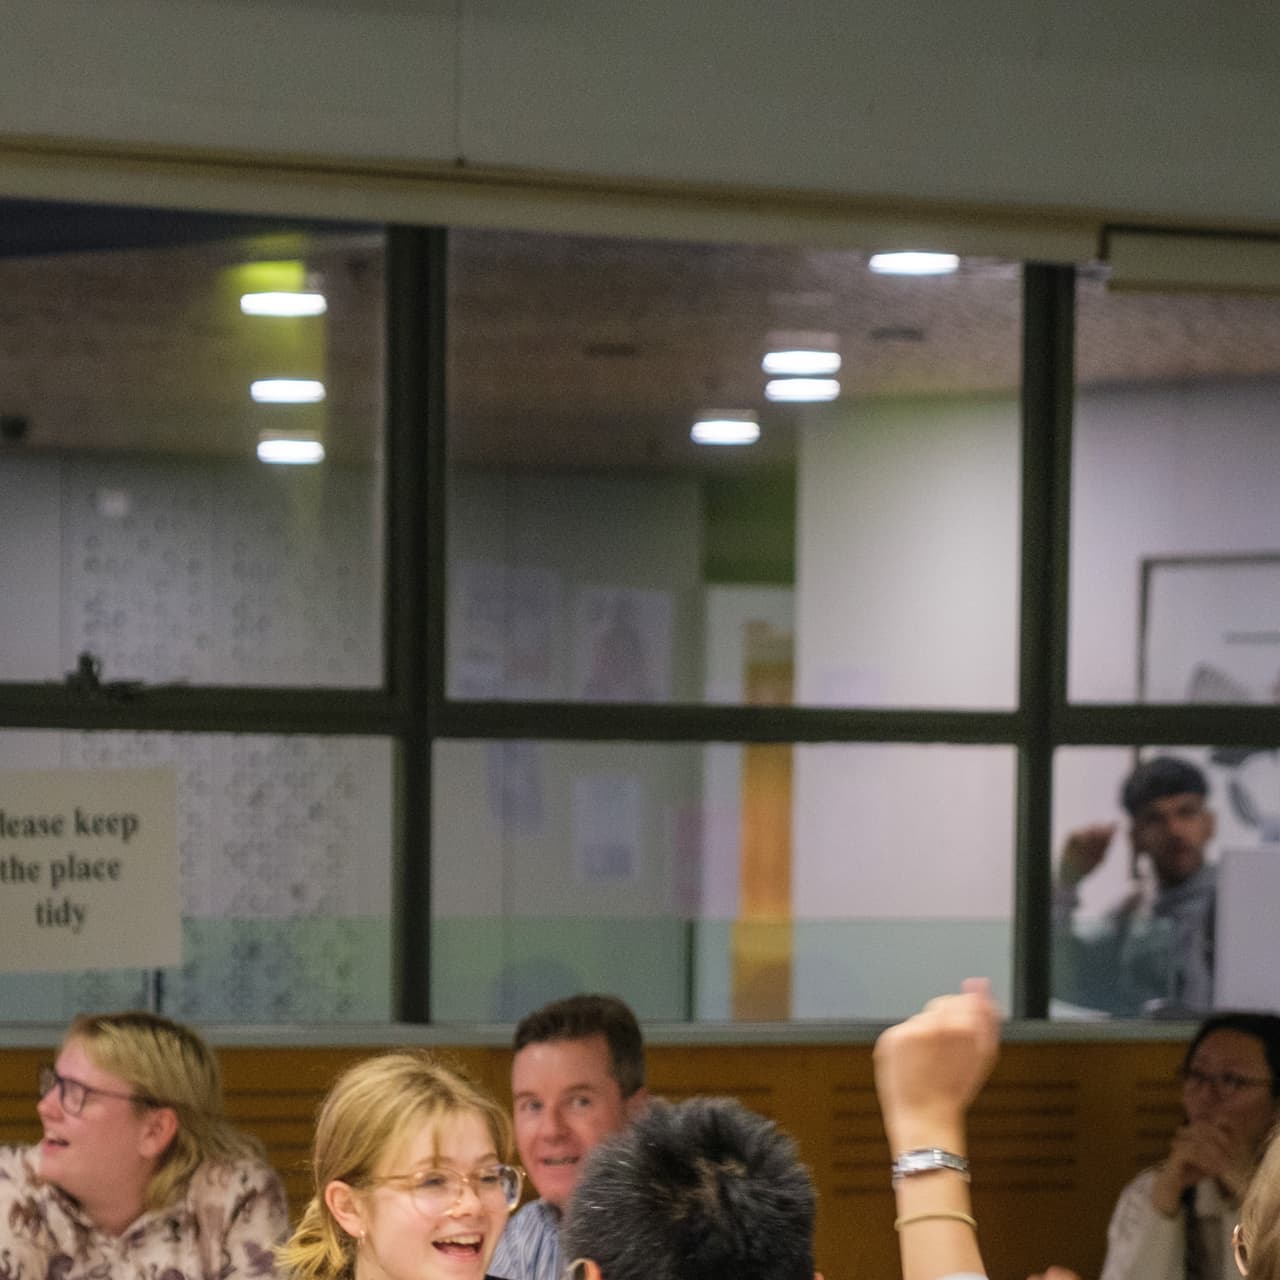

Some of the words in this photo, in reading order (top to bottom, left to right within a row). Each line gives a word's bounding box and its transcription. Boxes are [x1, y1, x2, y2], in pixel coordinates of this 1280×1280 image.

[74, 806, 138, 843] keep
[0, 855, 40, 884] the
[50, 853, 121, 889] place
[35, 898, 85, 934] tidy
